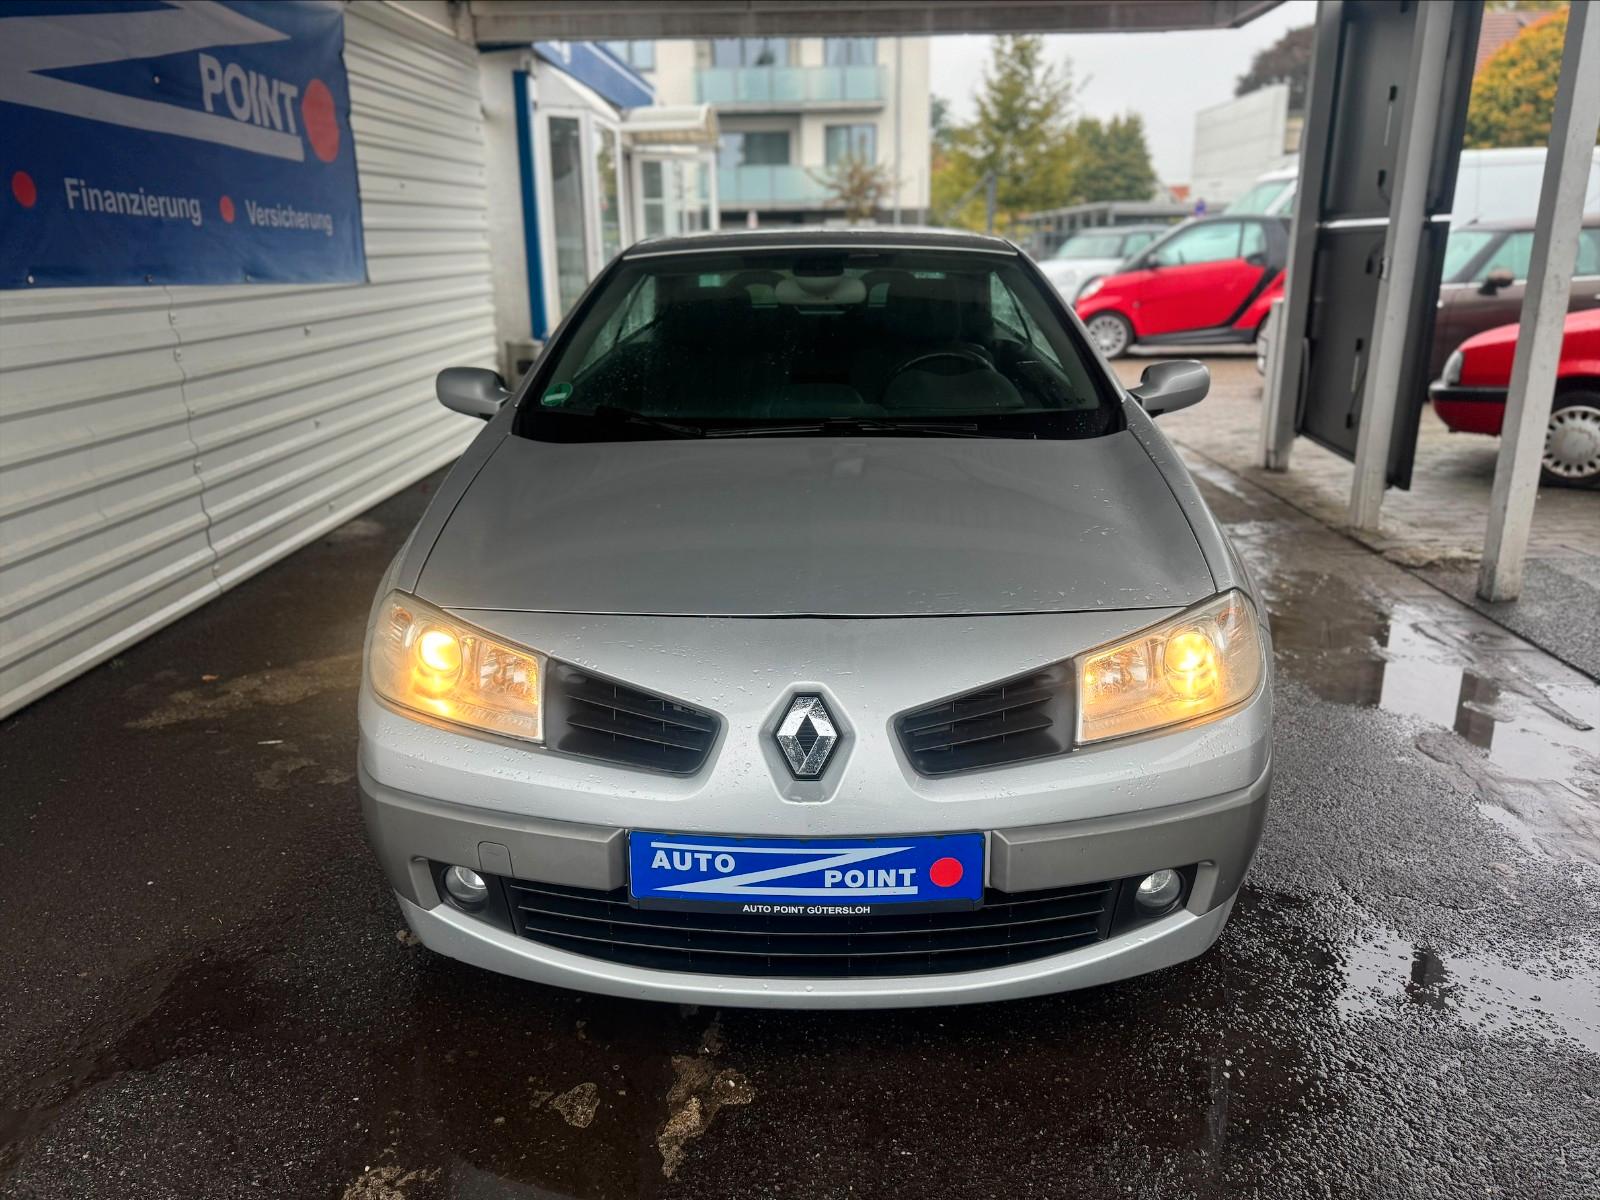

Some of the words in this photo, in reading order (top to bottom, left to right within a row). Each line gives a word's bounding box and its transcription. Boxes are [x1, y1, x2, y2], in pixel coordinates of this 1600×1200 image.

[199, 52, 298, 134] POINT
[64, 177, 203, 226] Finanzierung
[245, 199, 334, 236] Versicherung
[651, 849, 736, 874] AUTO
[824, 868, 917, 888] POINT
[742, 904, 772, 914] AUTO
[773, 905, 805, 915] POINT
[806, 905, 871, 915] GÜTERSLOH
